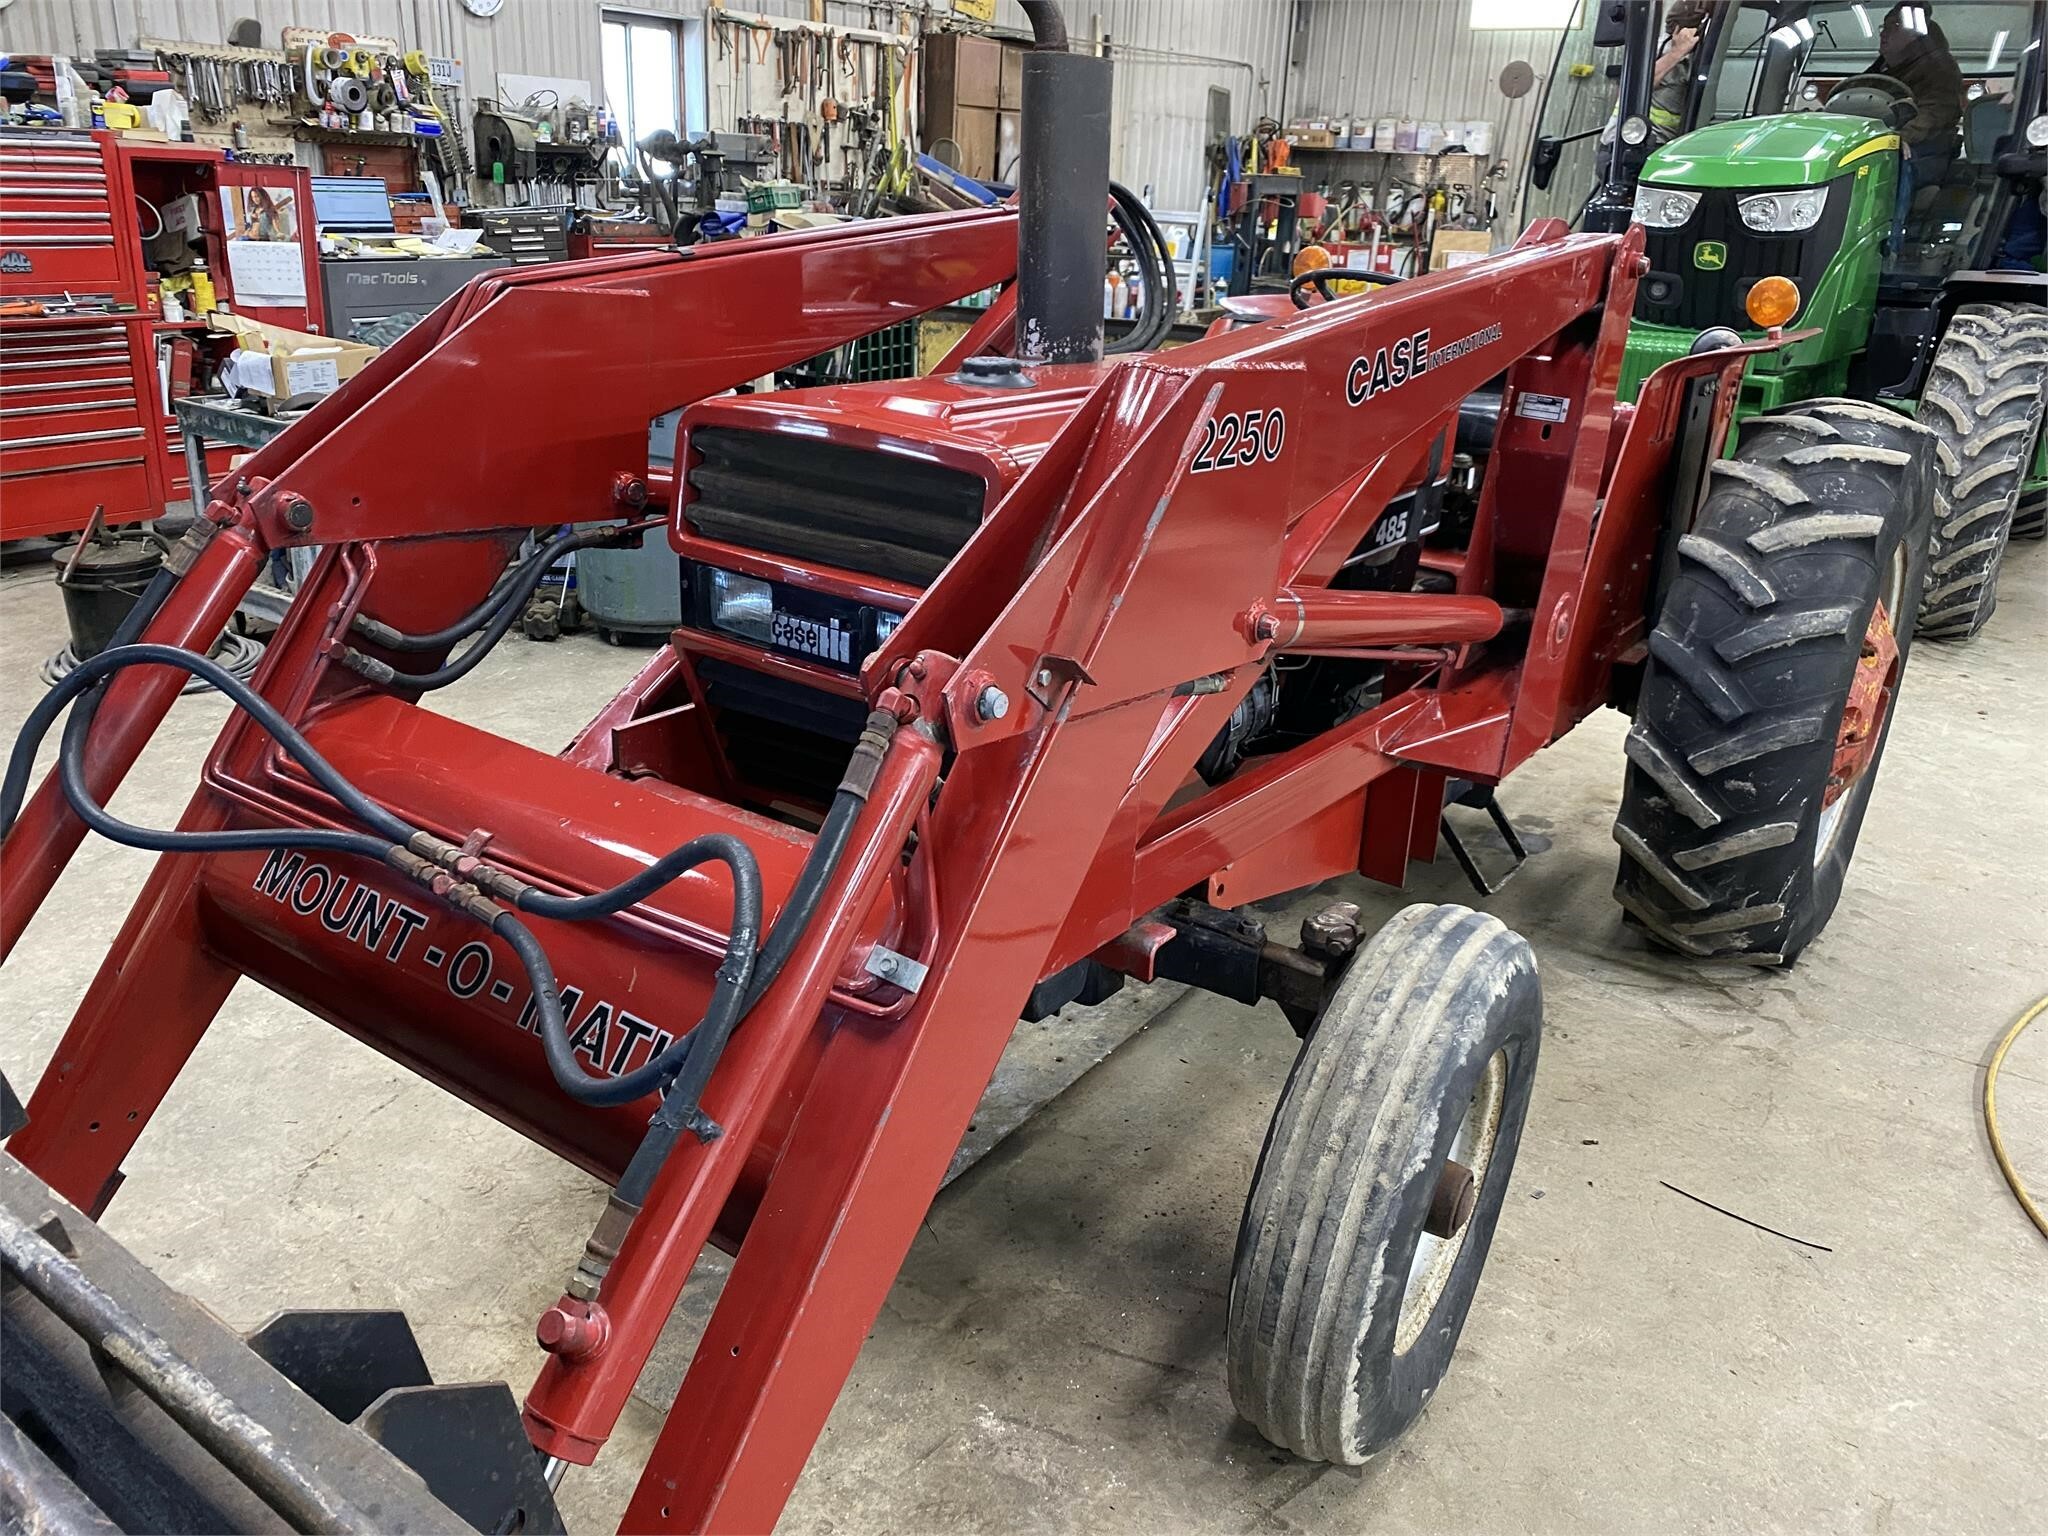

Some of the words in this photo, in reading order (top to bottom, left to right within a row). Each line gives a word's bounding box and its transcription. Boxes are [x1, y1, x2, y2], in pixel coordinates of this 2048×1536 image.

[346, 272, 379, 285] Mac
[380, 271, 418, 284] Tools
[1345, 327, 1431, 407] CASE
[1427, 321, 1503, 372] INTERNATIONAL
[1189, 406, 1285, 474] 2250
[1375, 510, 1409, 546] 485
